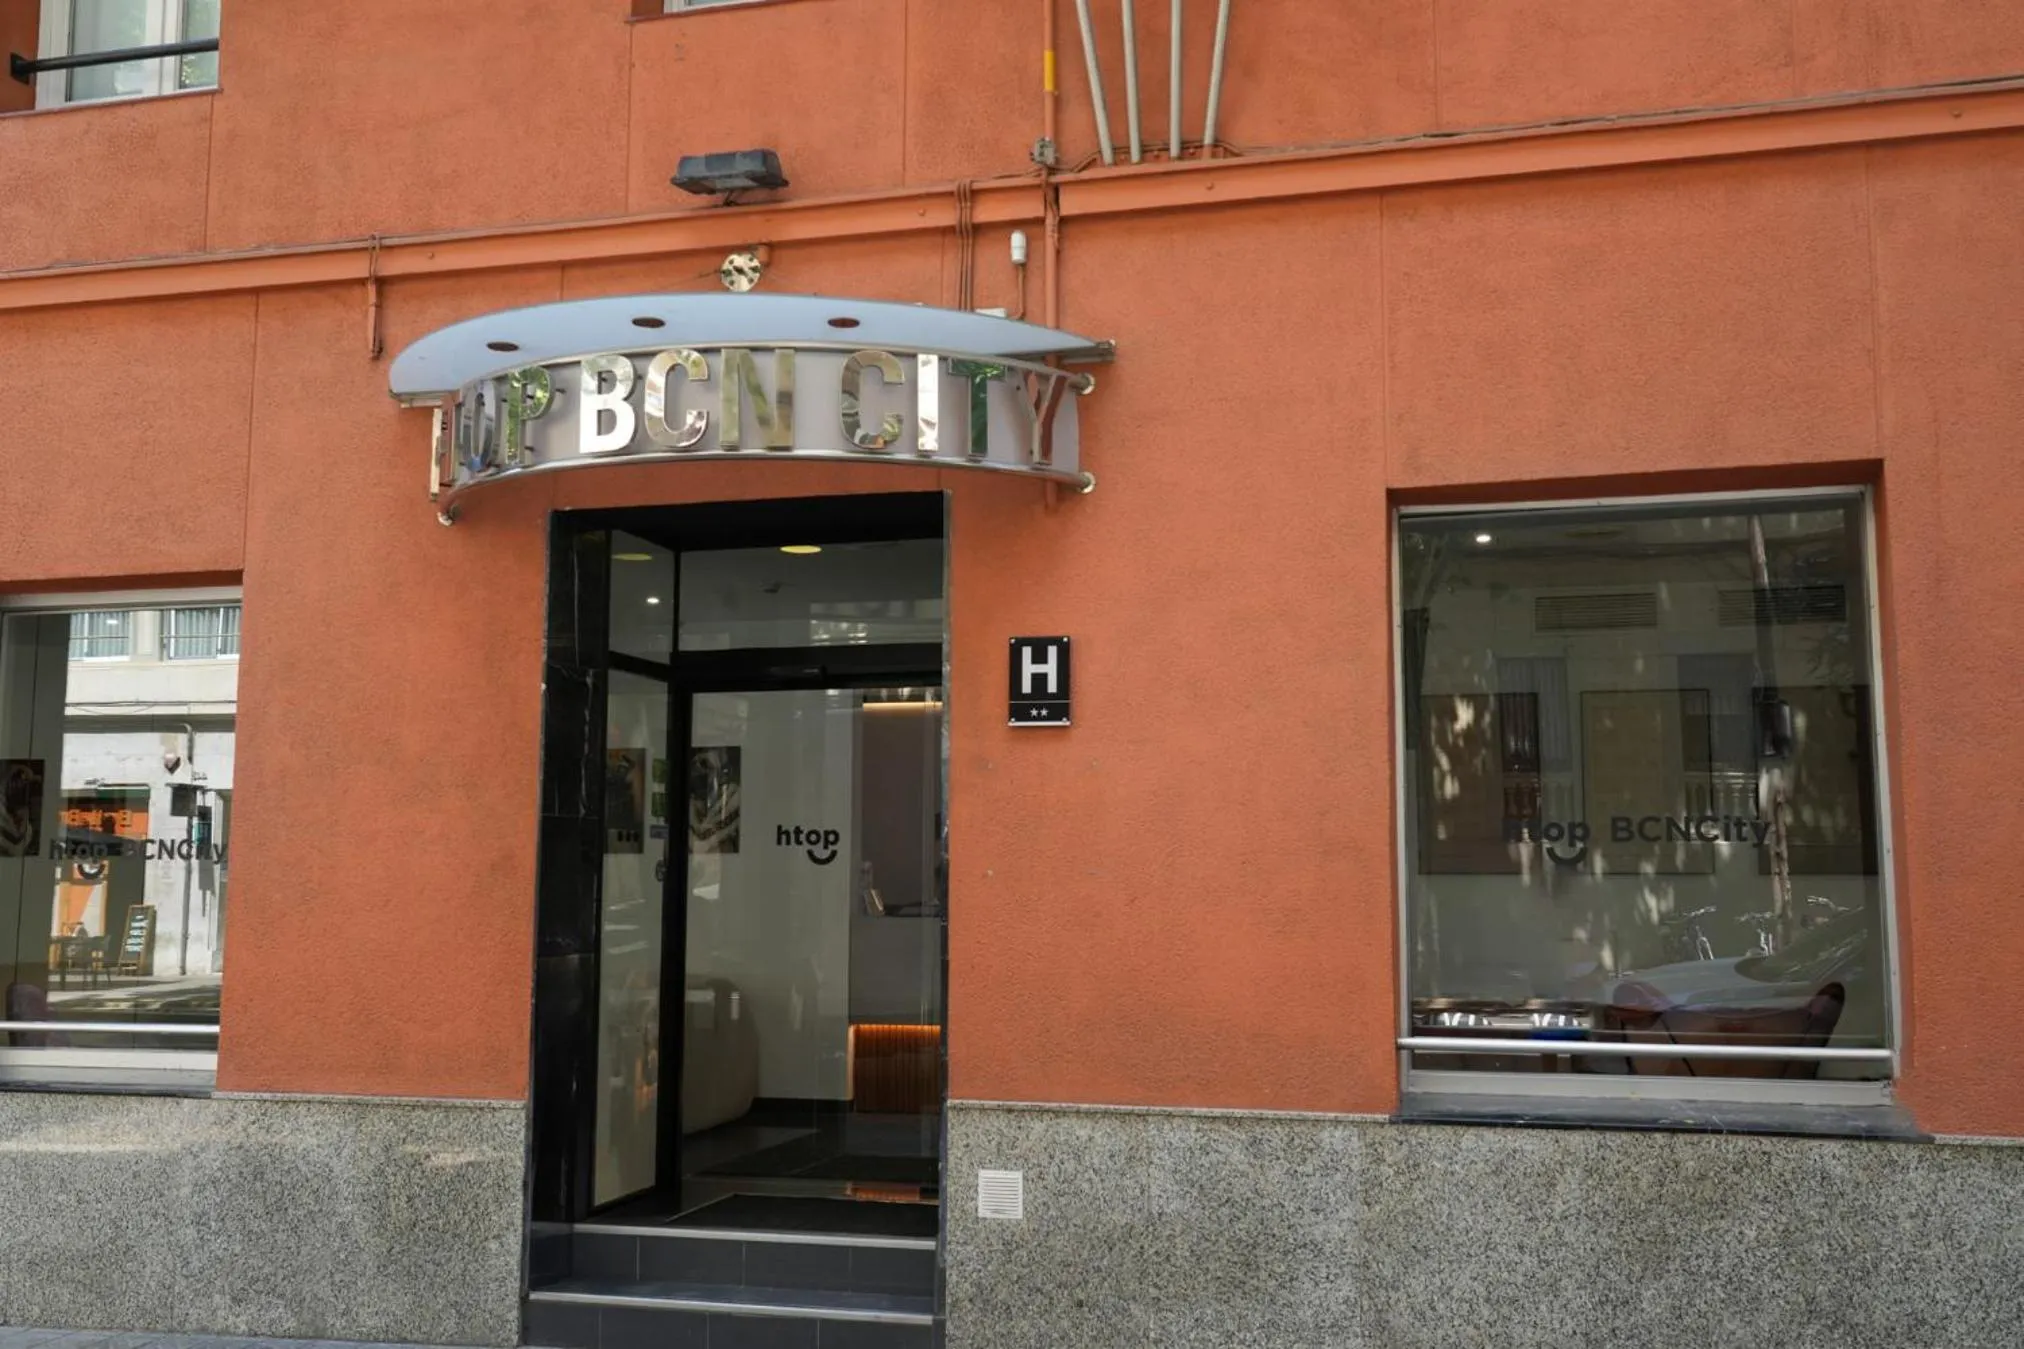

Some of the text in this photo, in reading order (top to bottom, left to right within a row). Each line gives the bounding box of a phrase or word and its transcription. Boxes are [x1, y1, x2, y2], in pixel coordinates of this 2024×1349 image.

[579, 348, 795, 455] BCN
[838, 350, 1068, 466] CITY
[1021, 645, 1058, 694] H
[776, 823, 840, 850] htop
[1609, 815, 1771, 848] BCNCity
